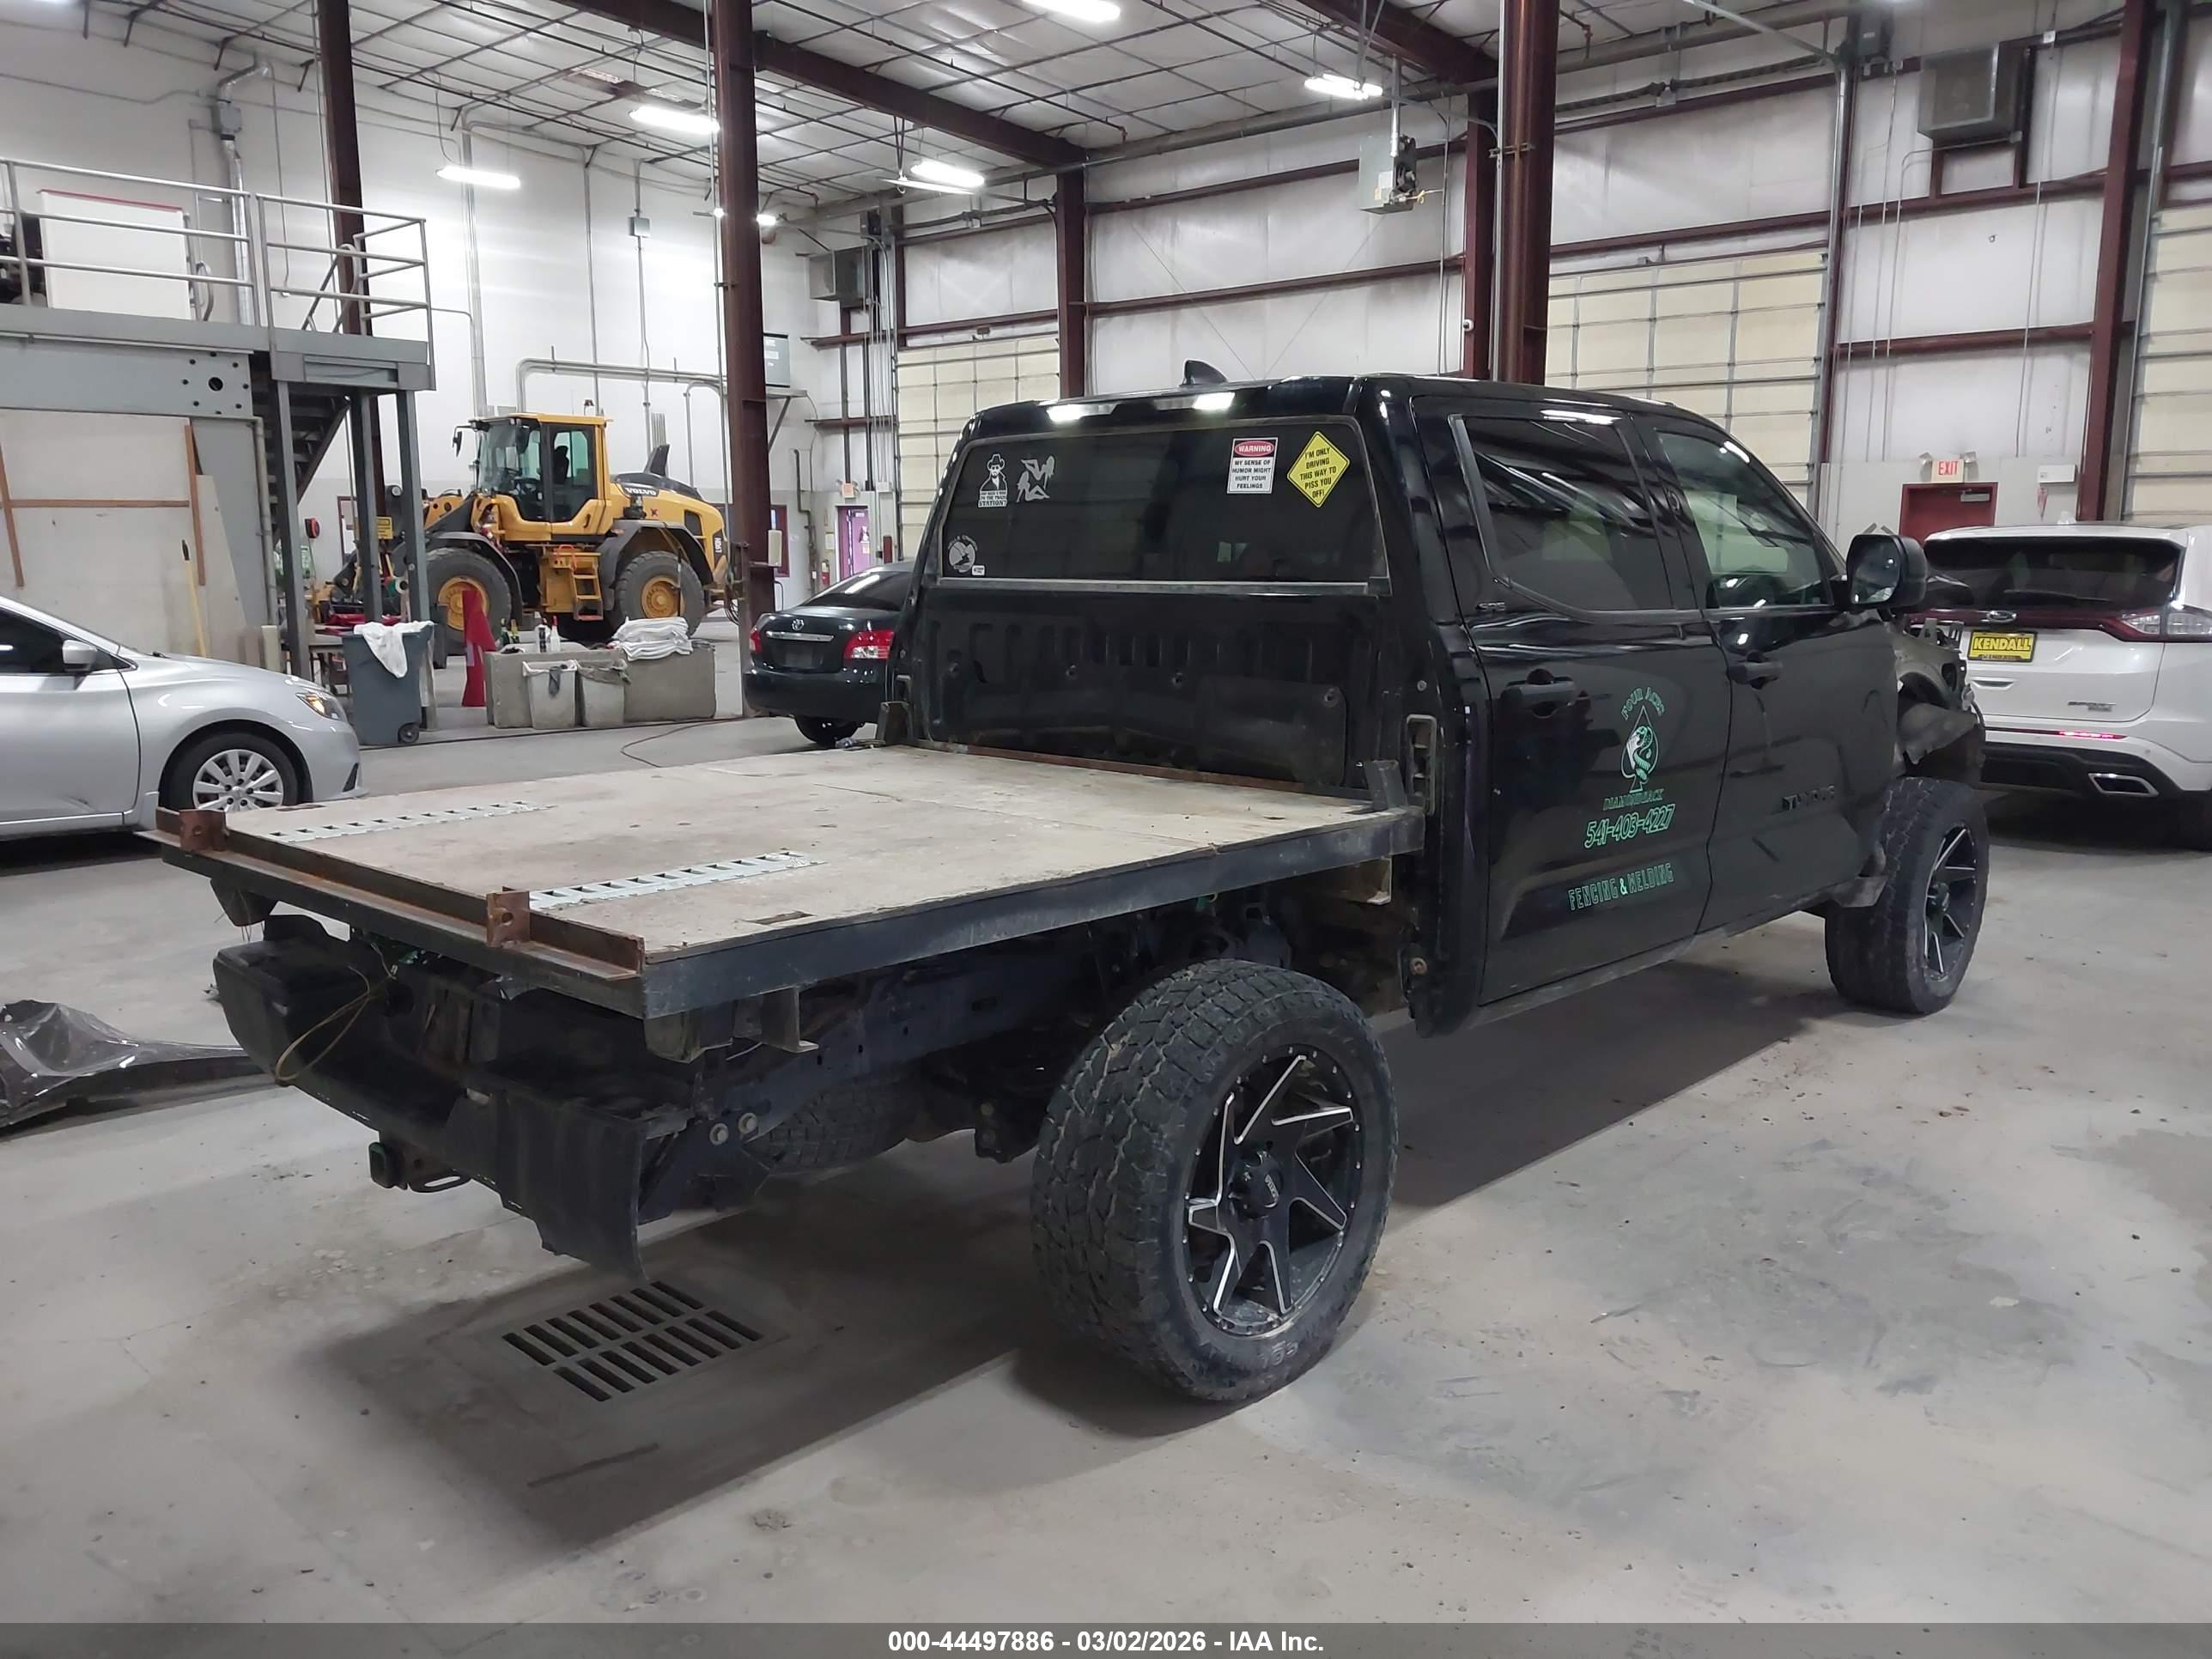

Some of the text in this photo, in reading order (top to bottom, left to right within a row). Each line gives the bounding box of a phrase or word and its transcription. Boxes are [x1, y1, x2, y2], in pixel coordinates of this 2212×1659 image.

[1304, 447, 1330, 459] I'M ONLY
[1306, 458, 1330, 469] DRIVING
[1938, 460, 1958, 476] EXIT
[1300, 471, 1313, 481] THIS
[1315, 468, 1328, 478] WAY
[1304, 477, 1332, 489] PISS YOU
[625, 487, 657, 495] VOLVO
[1312, 489, 1325, 498] OFF!
[1972, 636, 2031, 651] KENDALL
[1621, 688, 1644, 720] FOUR
[1584, 803, 1675, 848] 541-403-4227
[1568, 862, 1674, 911] FENCING & WELDING
